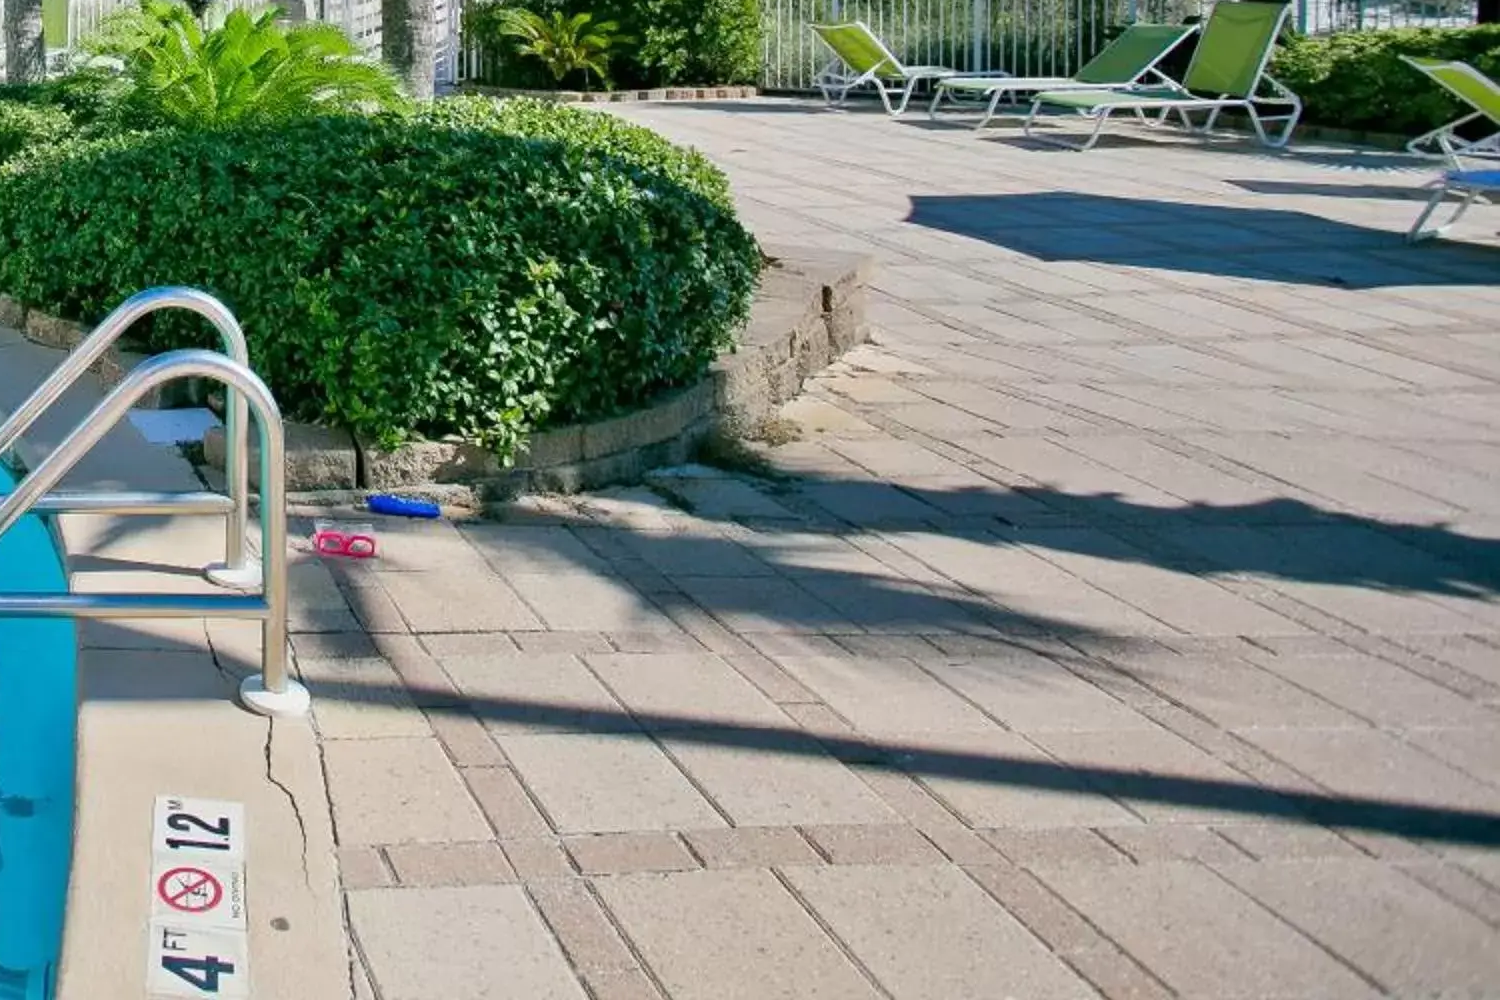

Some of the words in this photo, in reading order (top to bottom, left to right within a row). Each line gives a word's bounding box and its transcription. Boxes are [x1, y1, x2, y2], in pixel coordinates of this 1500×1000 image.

[231, 903, 240, 919] NO
[163, 927, 187, 951] FT
[162, 955, 234, 992] 4
